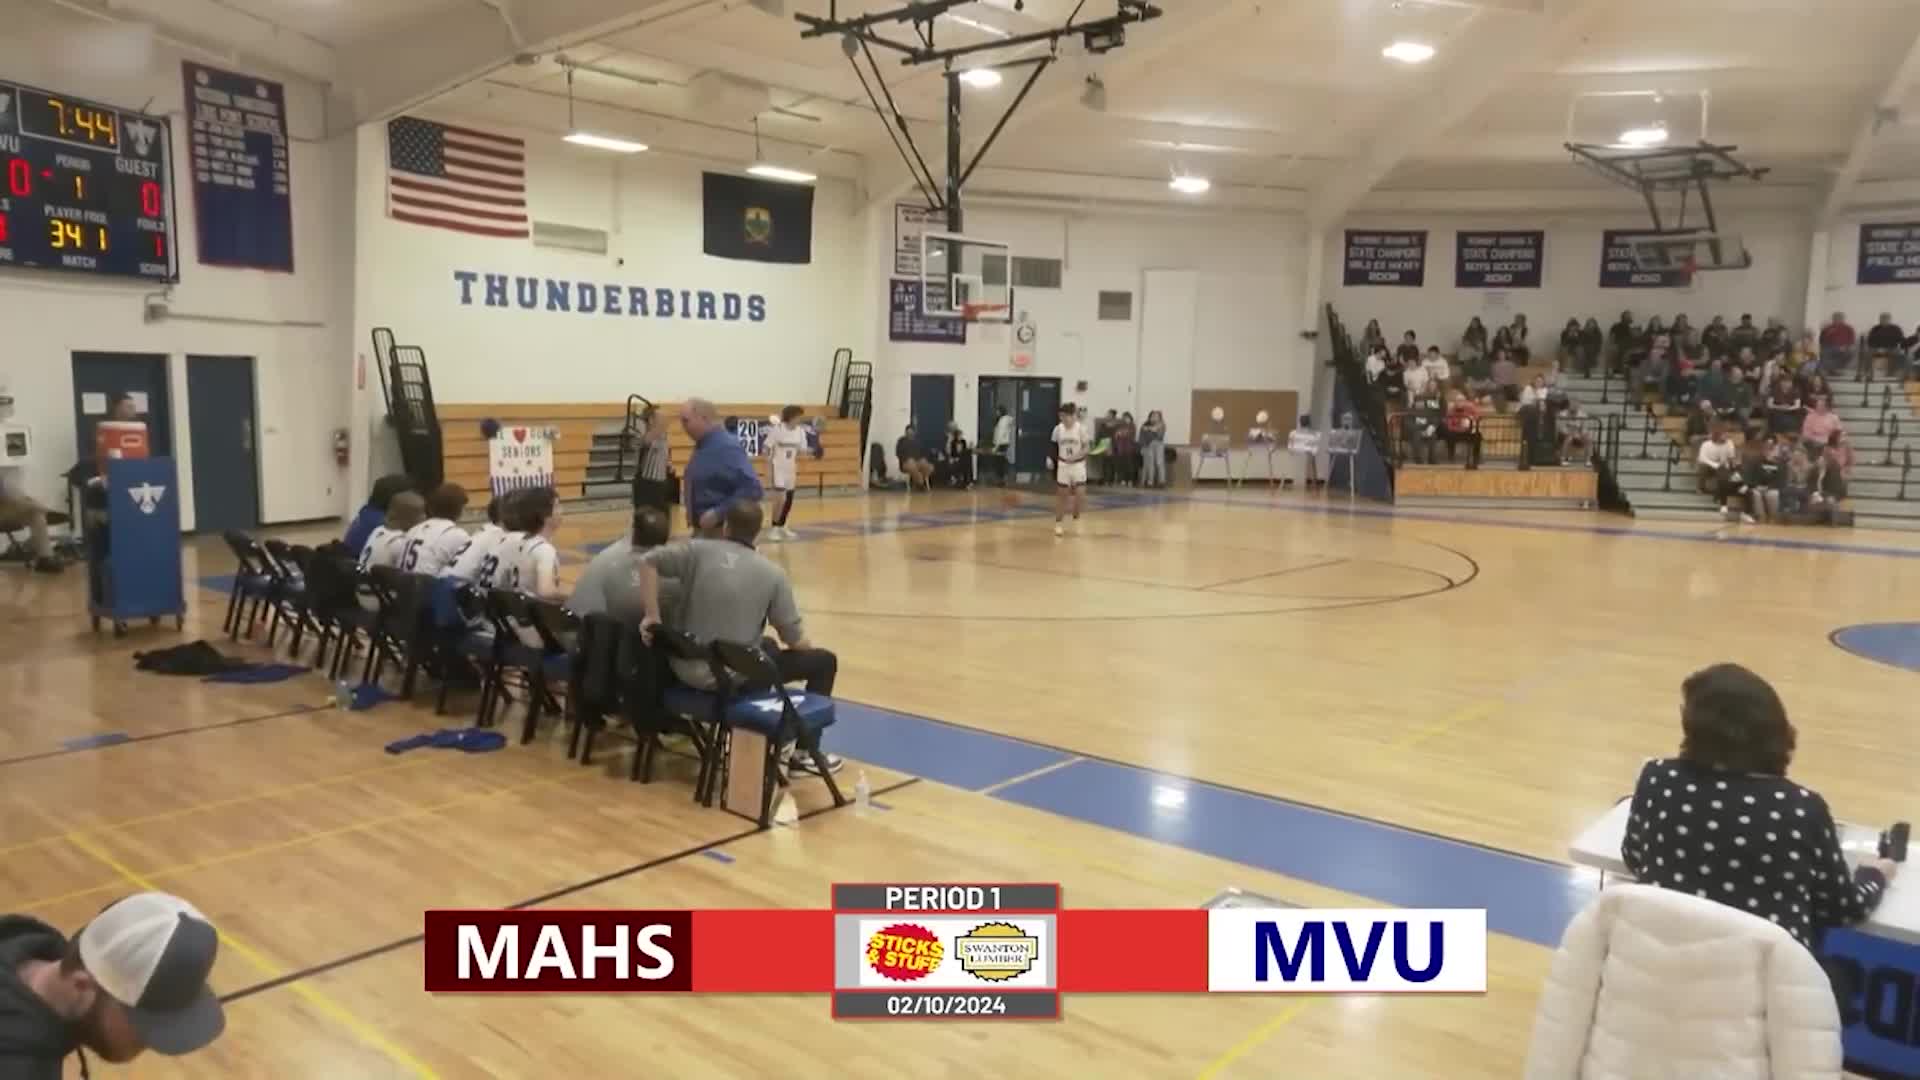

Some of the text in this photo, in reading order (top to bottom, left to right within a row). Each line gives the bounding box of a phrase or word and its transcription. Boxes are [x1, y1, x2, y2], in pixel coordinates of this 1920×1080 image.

[9, 157, 31, 197] 0
[115, 157, 159, 178] GUEST
[75, 175, 83, 199] 1
[140, 181, 161, 217] 0
[44, 204, 81, 220] PLAYER
[62, 255, 96, 269] MATCH
[454, 270, 767, 322] THUNDERBIRDS
[739, 421, 756, 437] 20
[502, 446, 542, 458] SENIORS
[401, 539, 424, 571] 15
